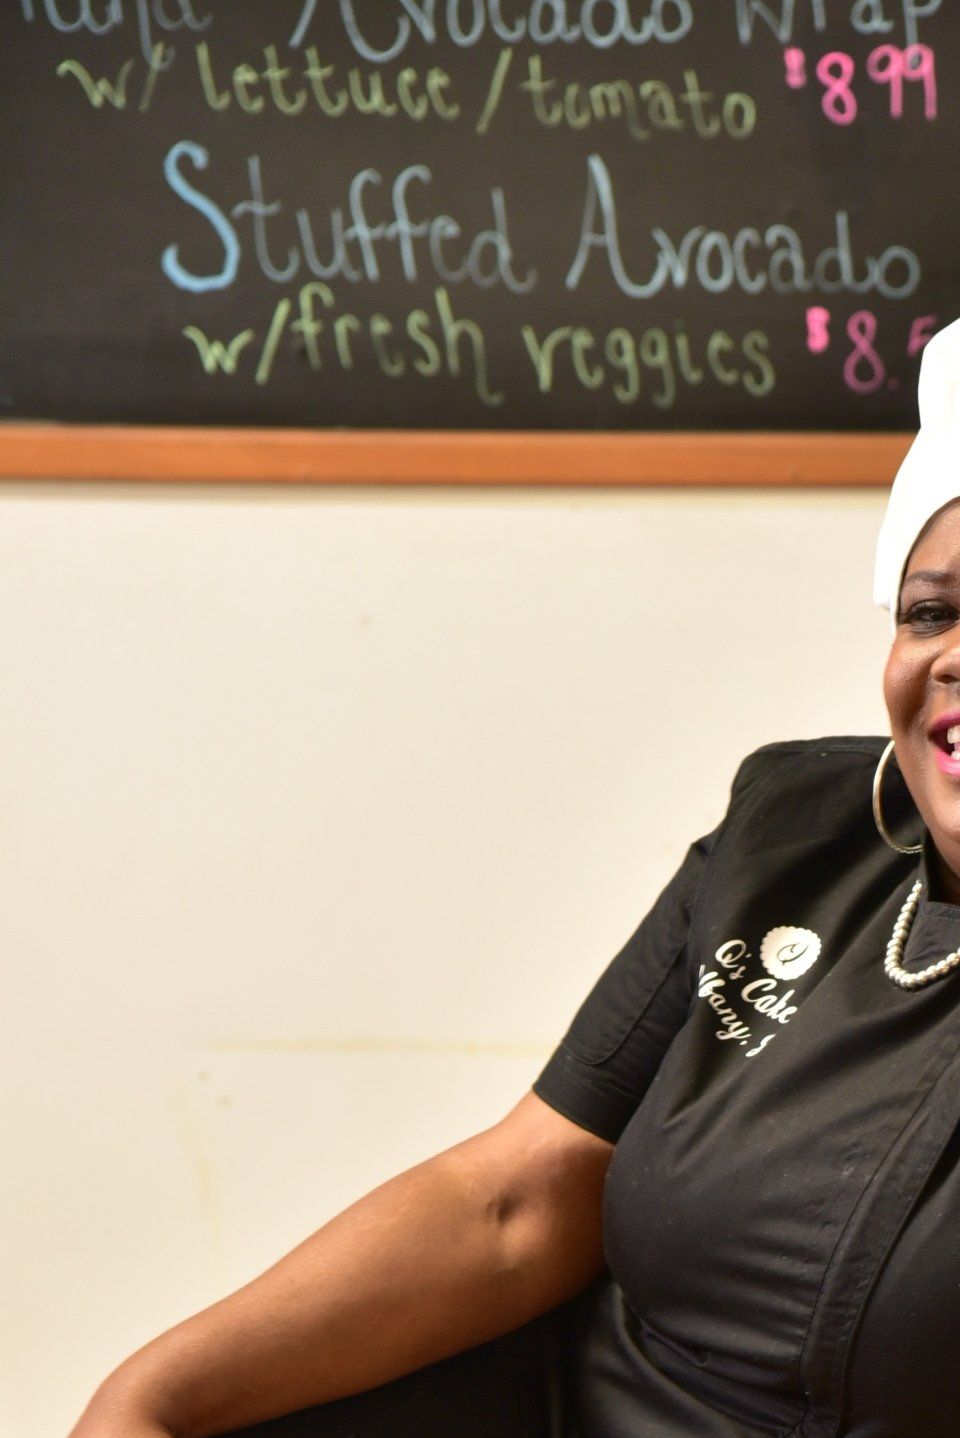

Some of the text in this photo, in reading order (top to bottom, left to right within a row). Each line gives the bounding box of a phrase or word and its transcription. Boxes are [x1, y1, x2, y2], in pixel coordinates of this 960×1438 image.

[161, 139, 921, 299] Stuffed Avocado
[714, 939, 752, 980] Q's
